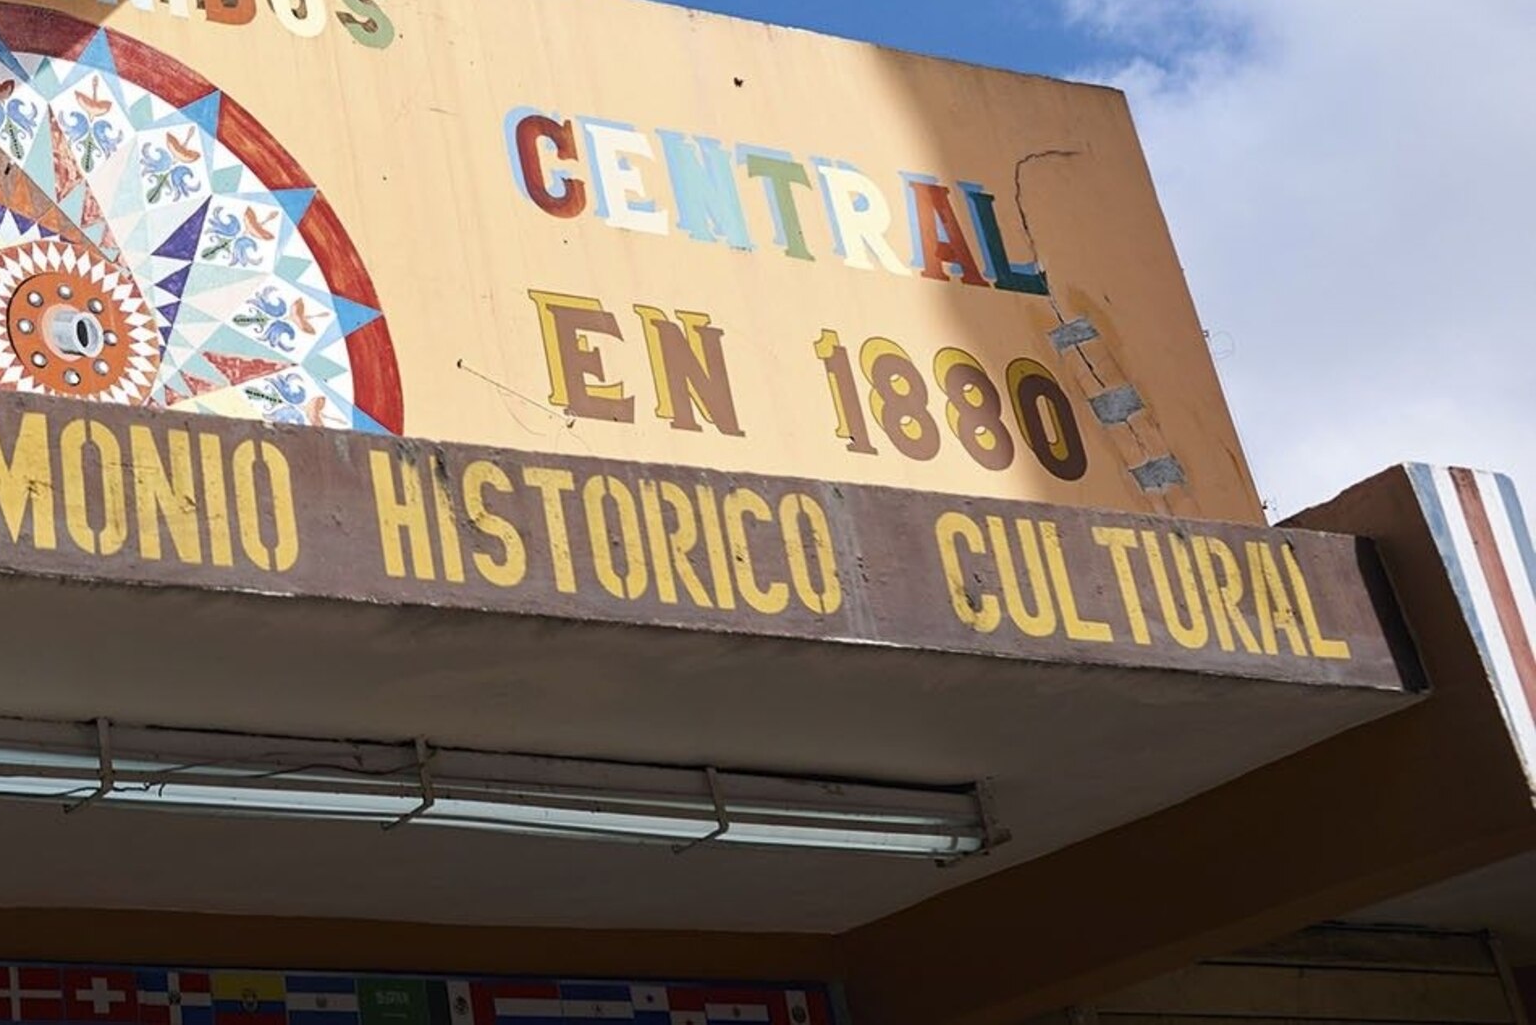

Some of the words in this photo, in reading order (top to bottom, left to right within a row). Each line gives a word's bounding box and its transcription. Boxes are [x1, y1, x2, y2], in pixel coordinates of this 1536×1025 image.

[503, 105, 1050, 296] CENTRAL
[527, 289, 746, 437] EN
[813, 329, 1088, 482] 1880
[369, 449, 842, 615] HISTORICO
[934, 511, 1352, 660] CULTURAL
